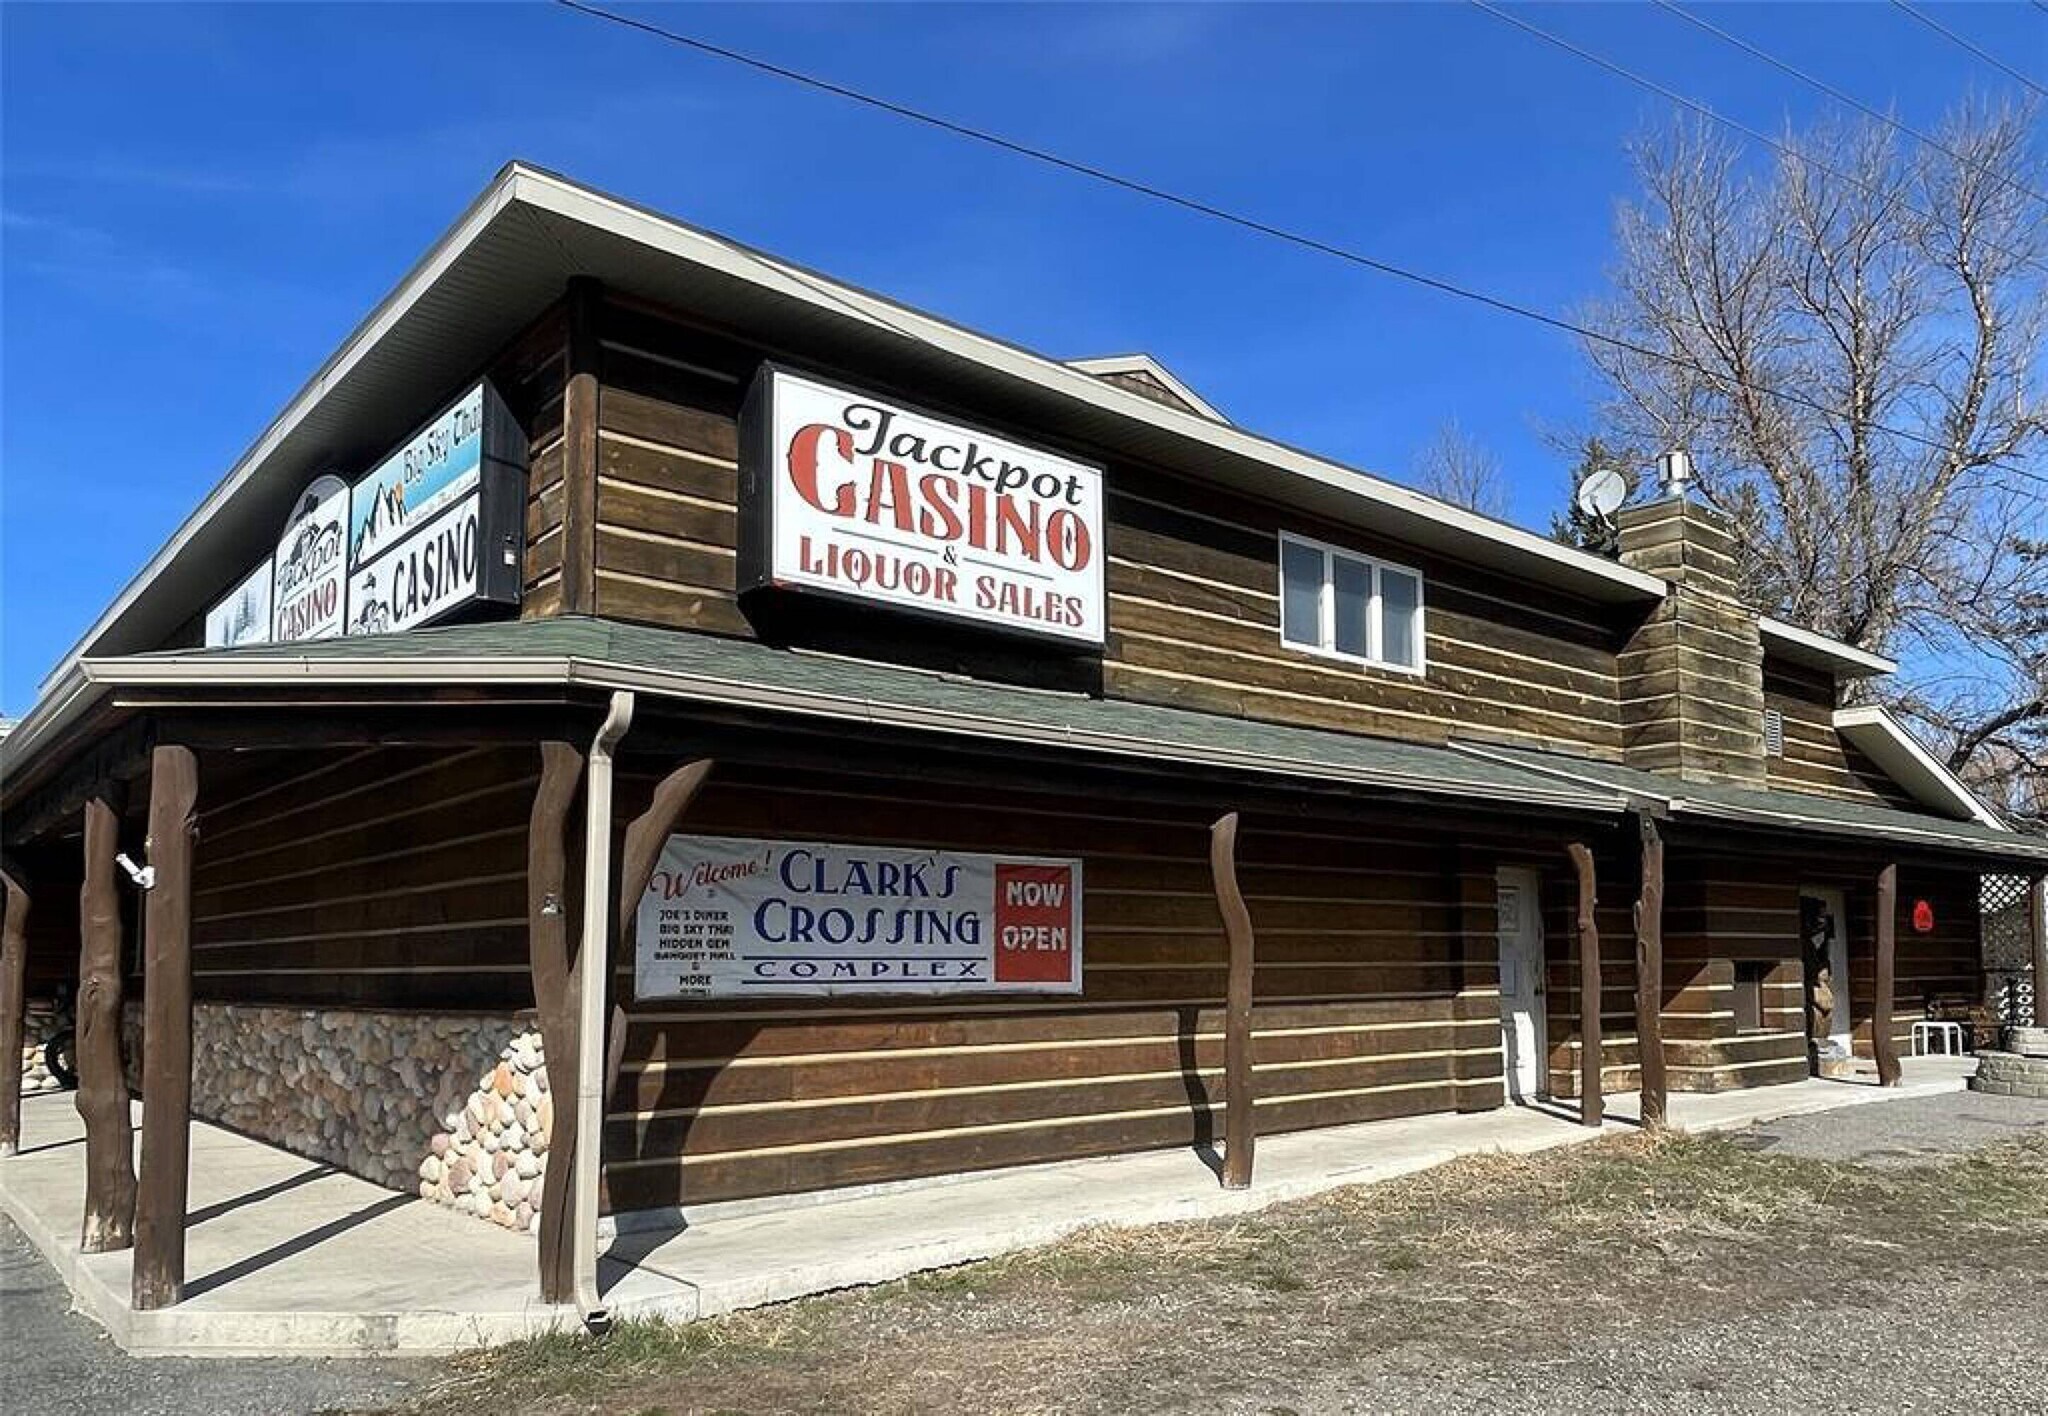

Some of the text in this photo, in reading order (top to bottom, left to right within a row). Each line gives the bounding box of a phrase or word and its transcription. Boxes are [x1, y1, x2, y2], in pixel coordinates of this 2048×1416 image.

[403, 447, 424, 485] Big
[427, 429, 449, 467] Sky
[842, 403, 1085, 506] Jackpot
[786, 422, 1092, 573] CASINO
[277, 525, 343, 602] Jackpot
[393, 513, 477, 623] CASINO
[943, 545, 958, 566] &
[799, 535, 1084, 628] LIQUOR SALES
[277, 577, 337, 640] CASINO
[779, 849, 960, 899] CLARK'S
[1006, 880, 1065, 908] NOW
[659, 924, 680, 934] BIG
[659, 937, 702, 948] HIDDEN
[753, 897, 981, 944] CROSSING
[1002, 925, 1067, 951] OPEN
[679, 975, 712, 986] MORE
[753, 961, 978, 977] COMPLEX
